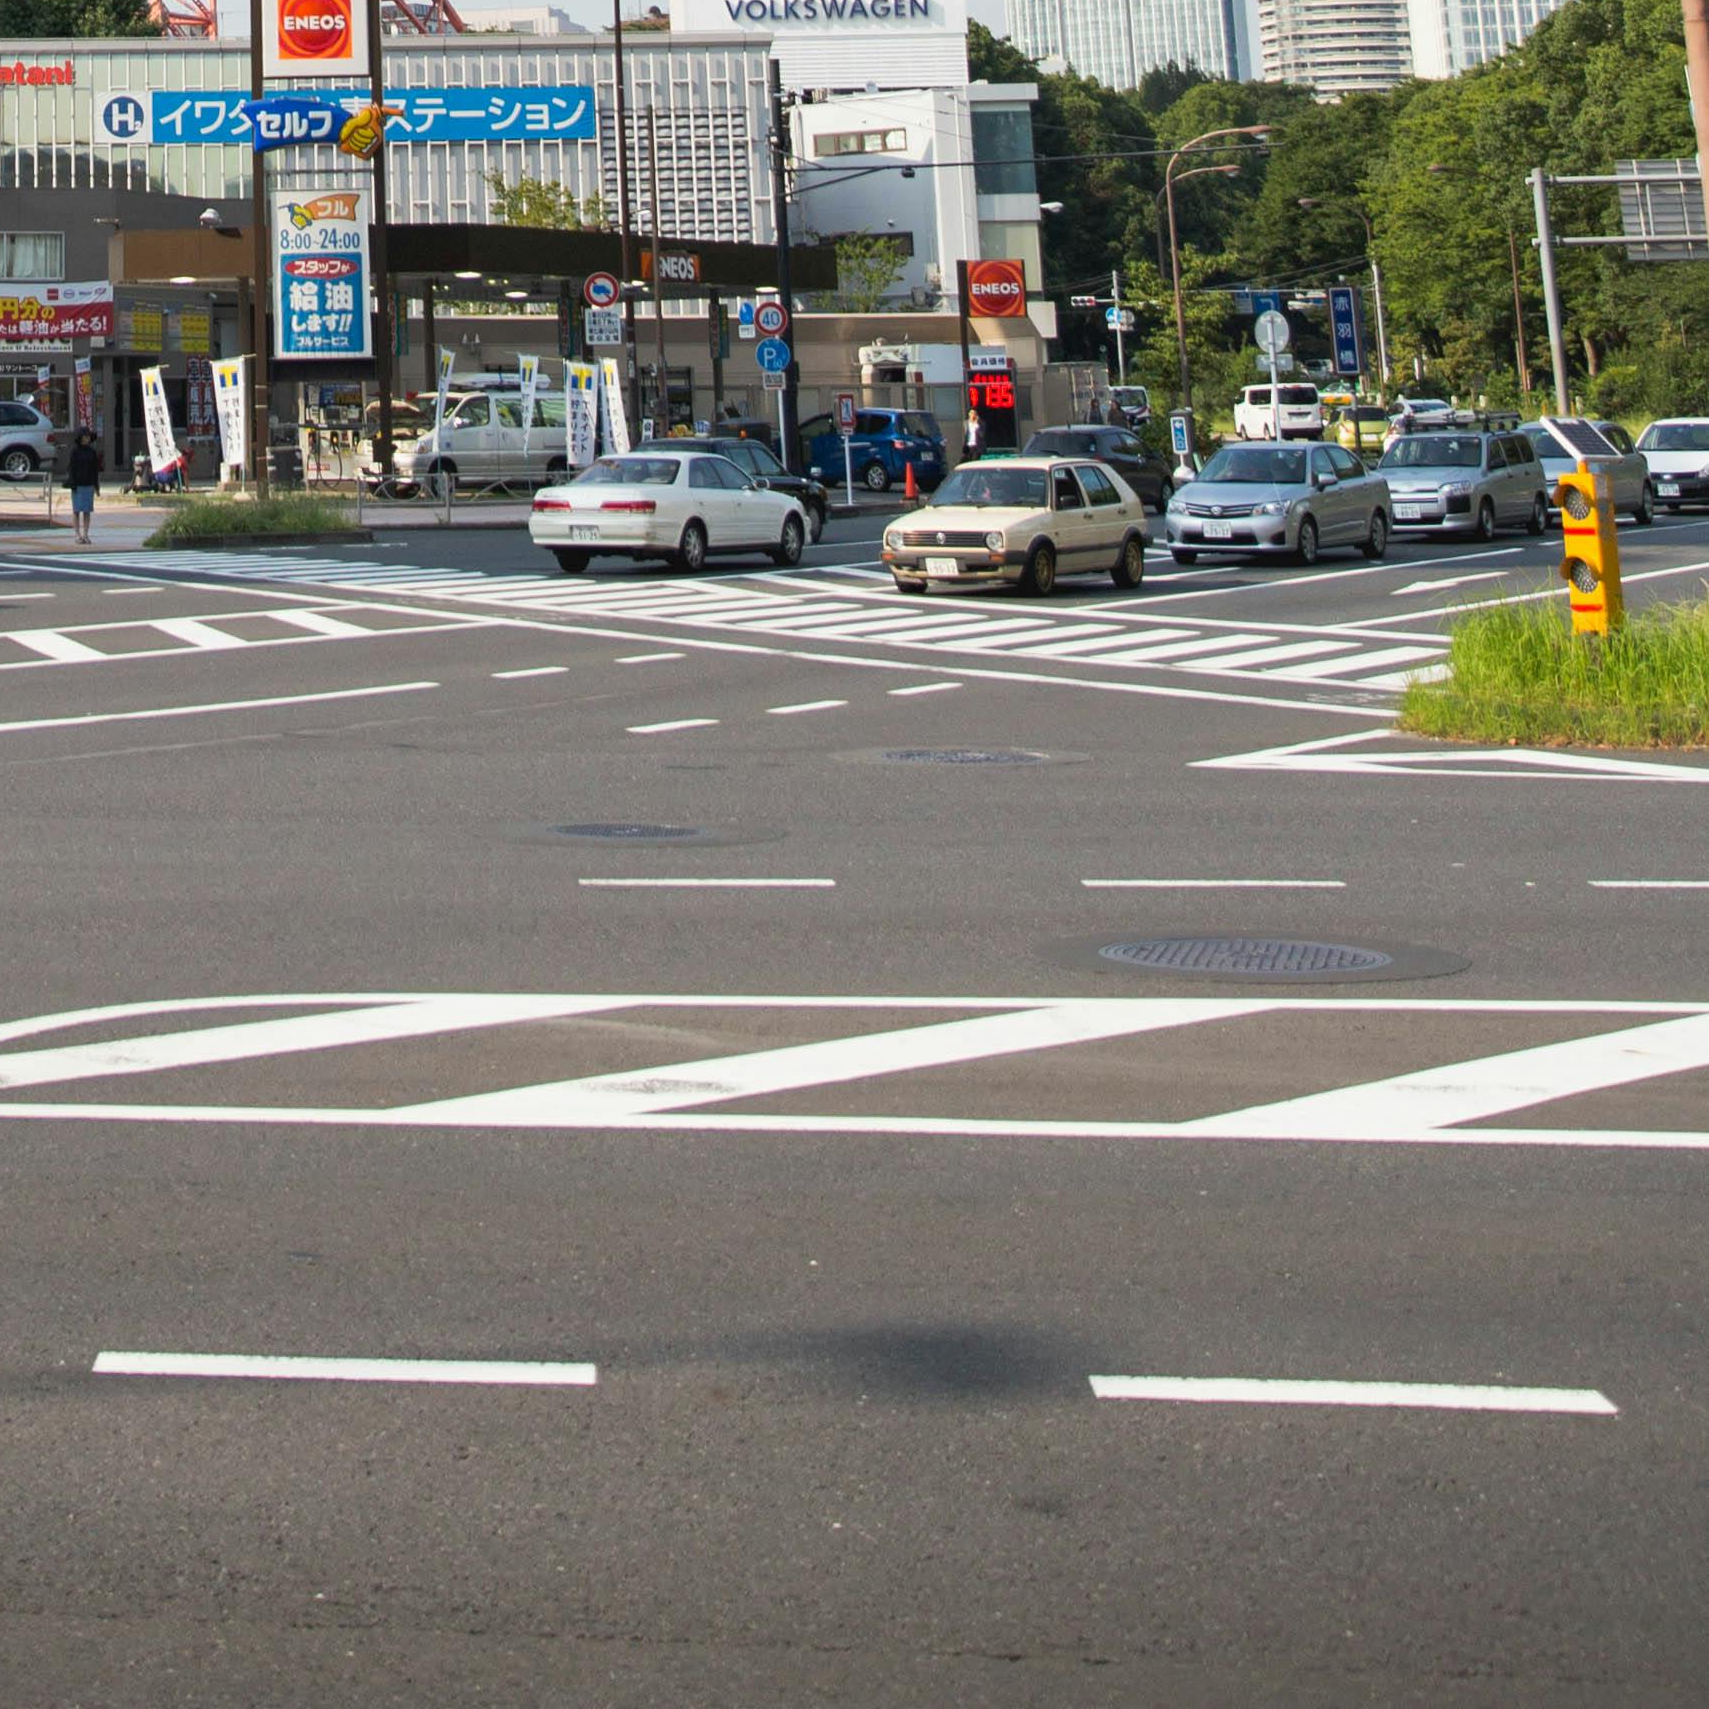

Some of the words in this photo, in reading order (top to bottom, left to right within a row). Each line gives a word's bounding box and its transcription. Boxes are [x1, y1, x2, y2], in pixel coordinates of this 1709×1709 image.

[284, 14, 346, 30] ENEOS
[159, 97, 587, 137] イワタステーション
[256, 110, 332, 138] セルフ
[317, 200, 349, 217] フル
[294, 260, 350, 275] スタッフが
[289, 281, 354, 312] 給油
[971, 282, 1020, 295] ENEOS
[762, 311, 781, 327] 40
[764, 347, 777, 368] P
